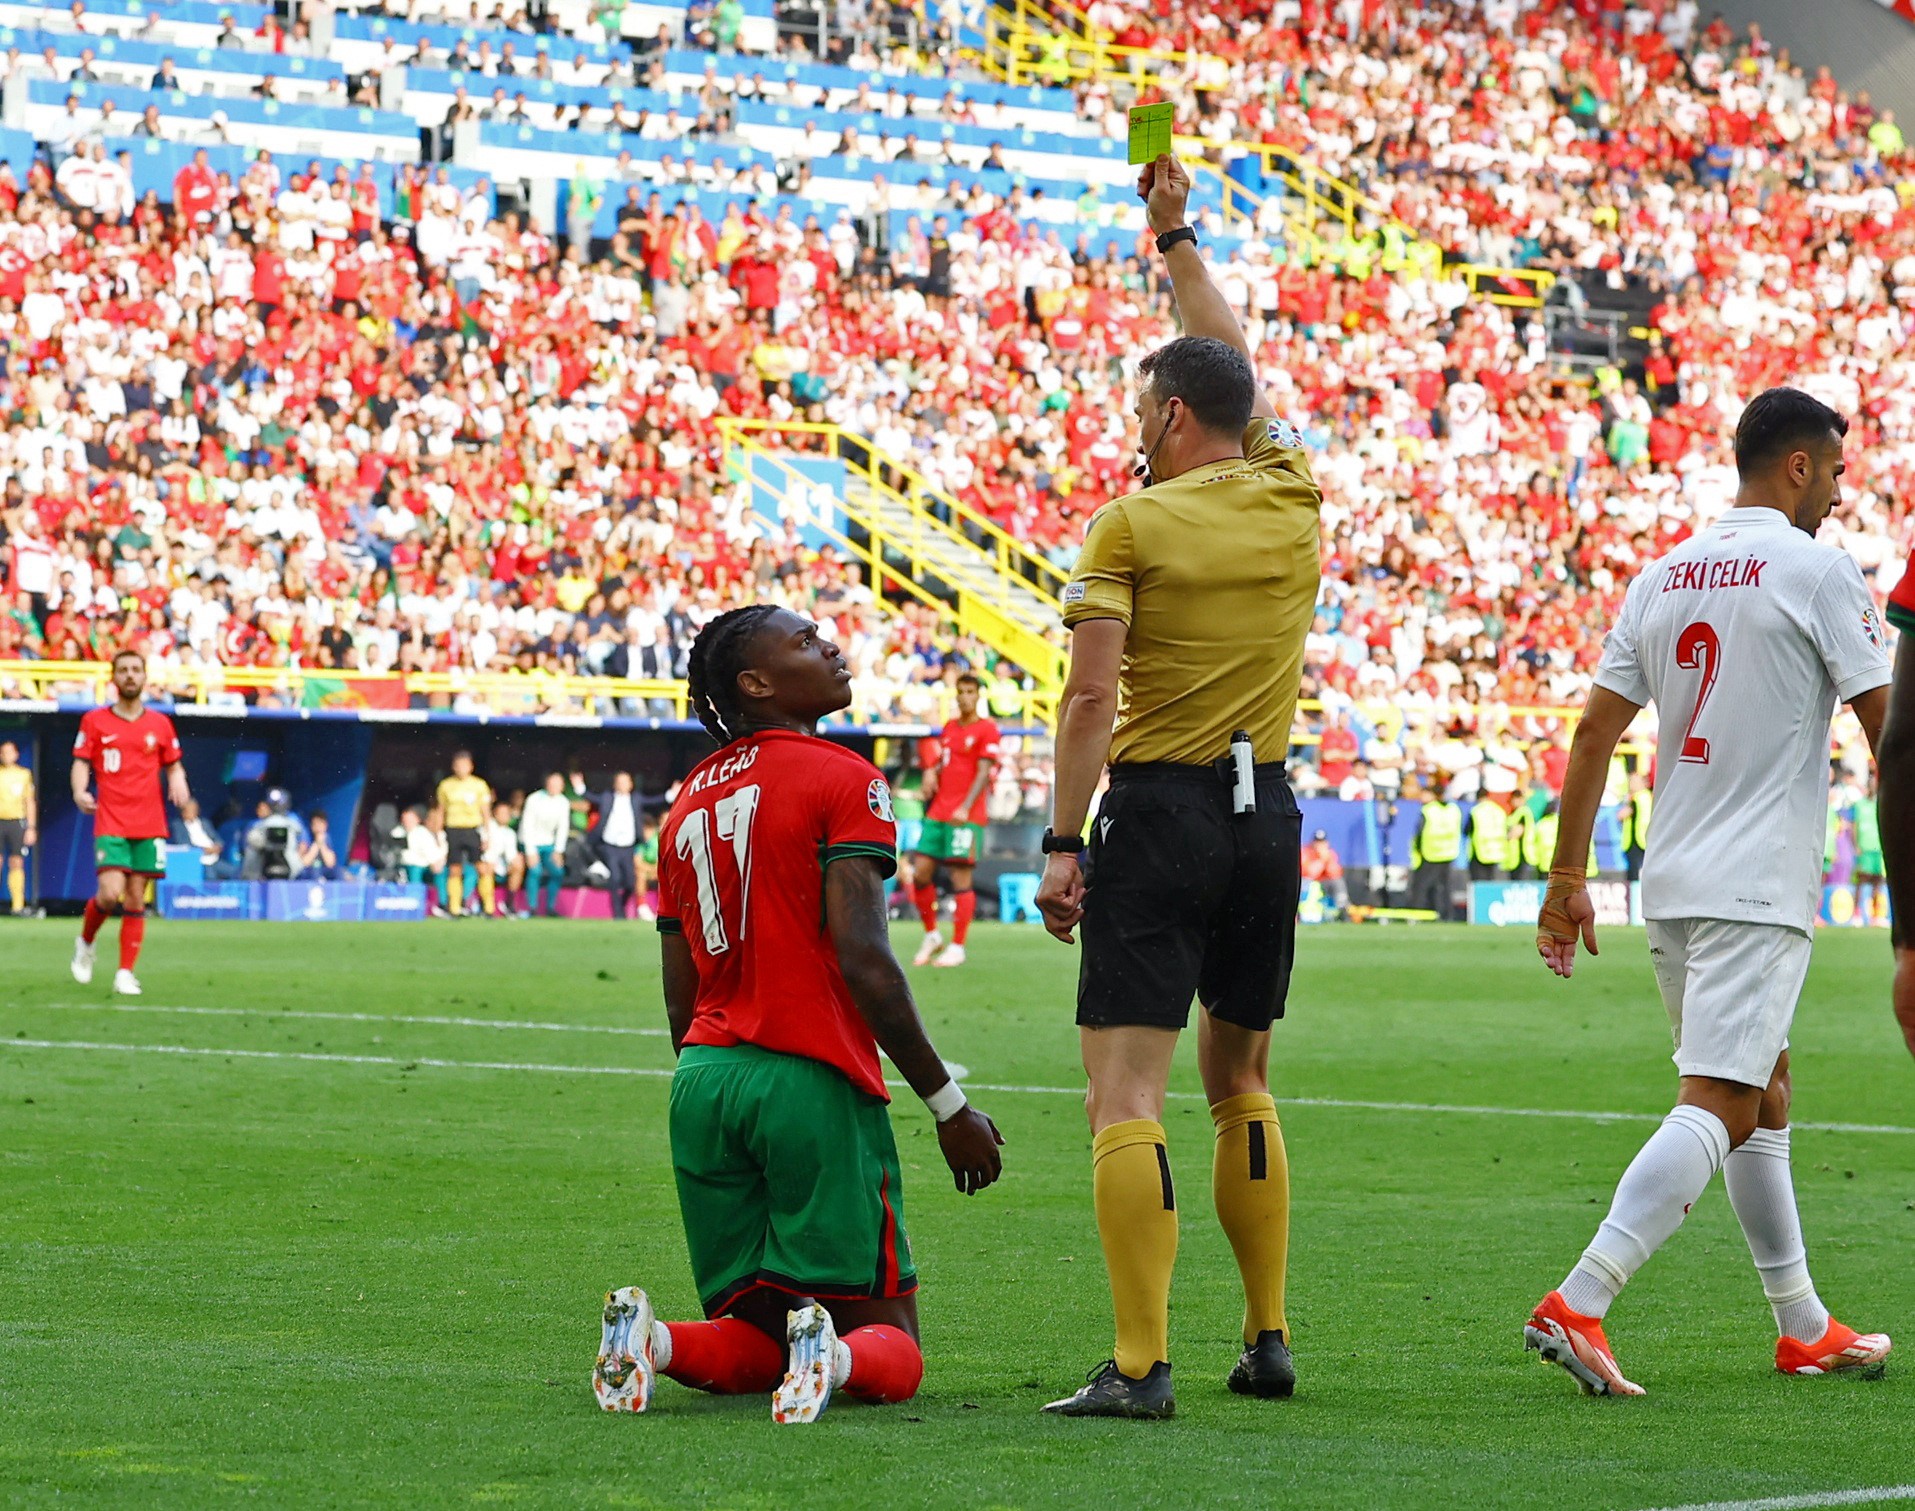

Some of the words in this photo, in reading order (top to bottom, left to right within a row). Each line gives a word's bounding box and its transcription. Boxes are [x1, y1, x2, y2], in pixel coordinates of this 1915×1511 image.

[1662, 557, 1708, 593] ZEKİ
[1709, 553, 1768, 593] ÇELİK
[1676, 621, 1721, 764] 2
[101, 748, 121, 773] 10
[688, 745, 759, 797] R.LEÃO
[675, 784, 761, 956] 17
